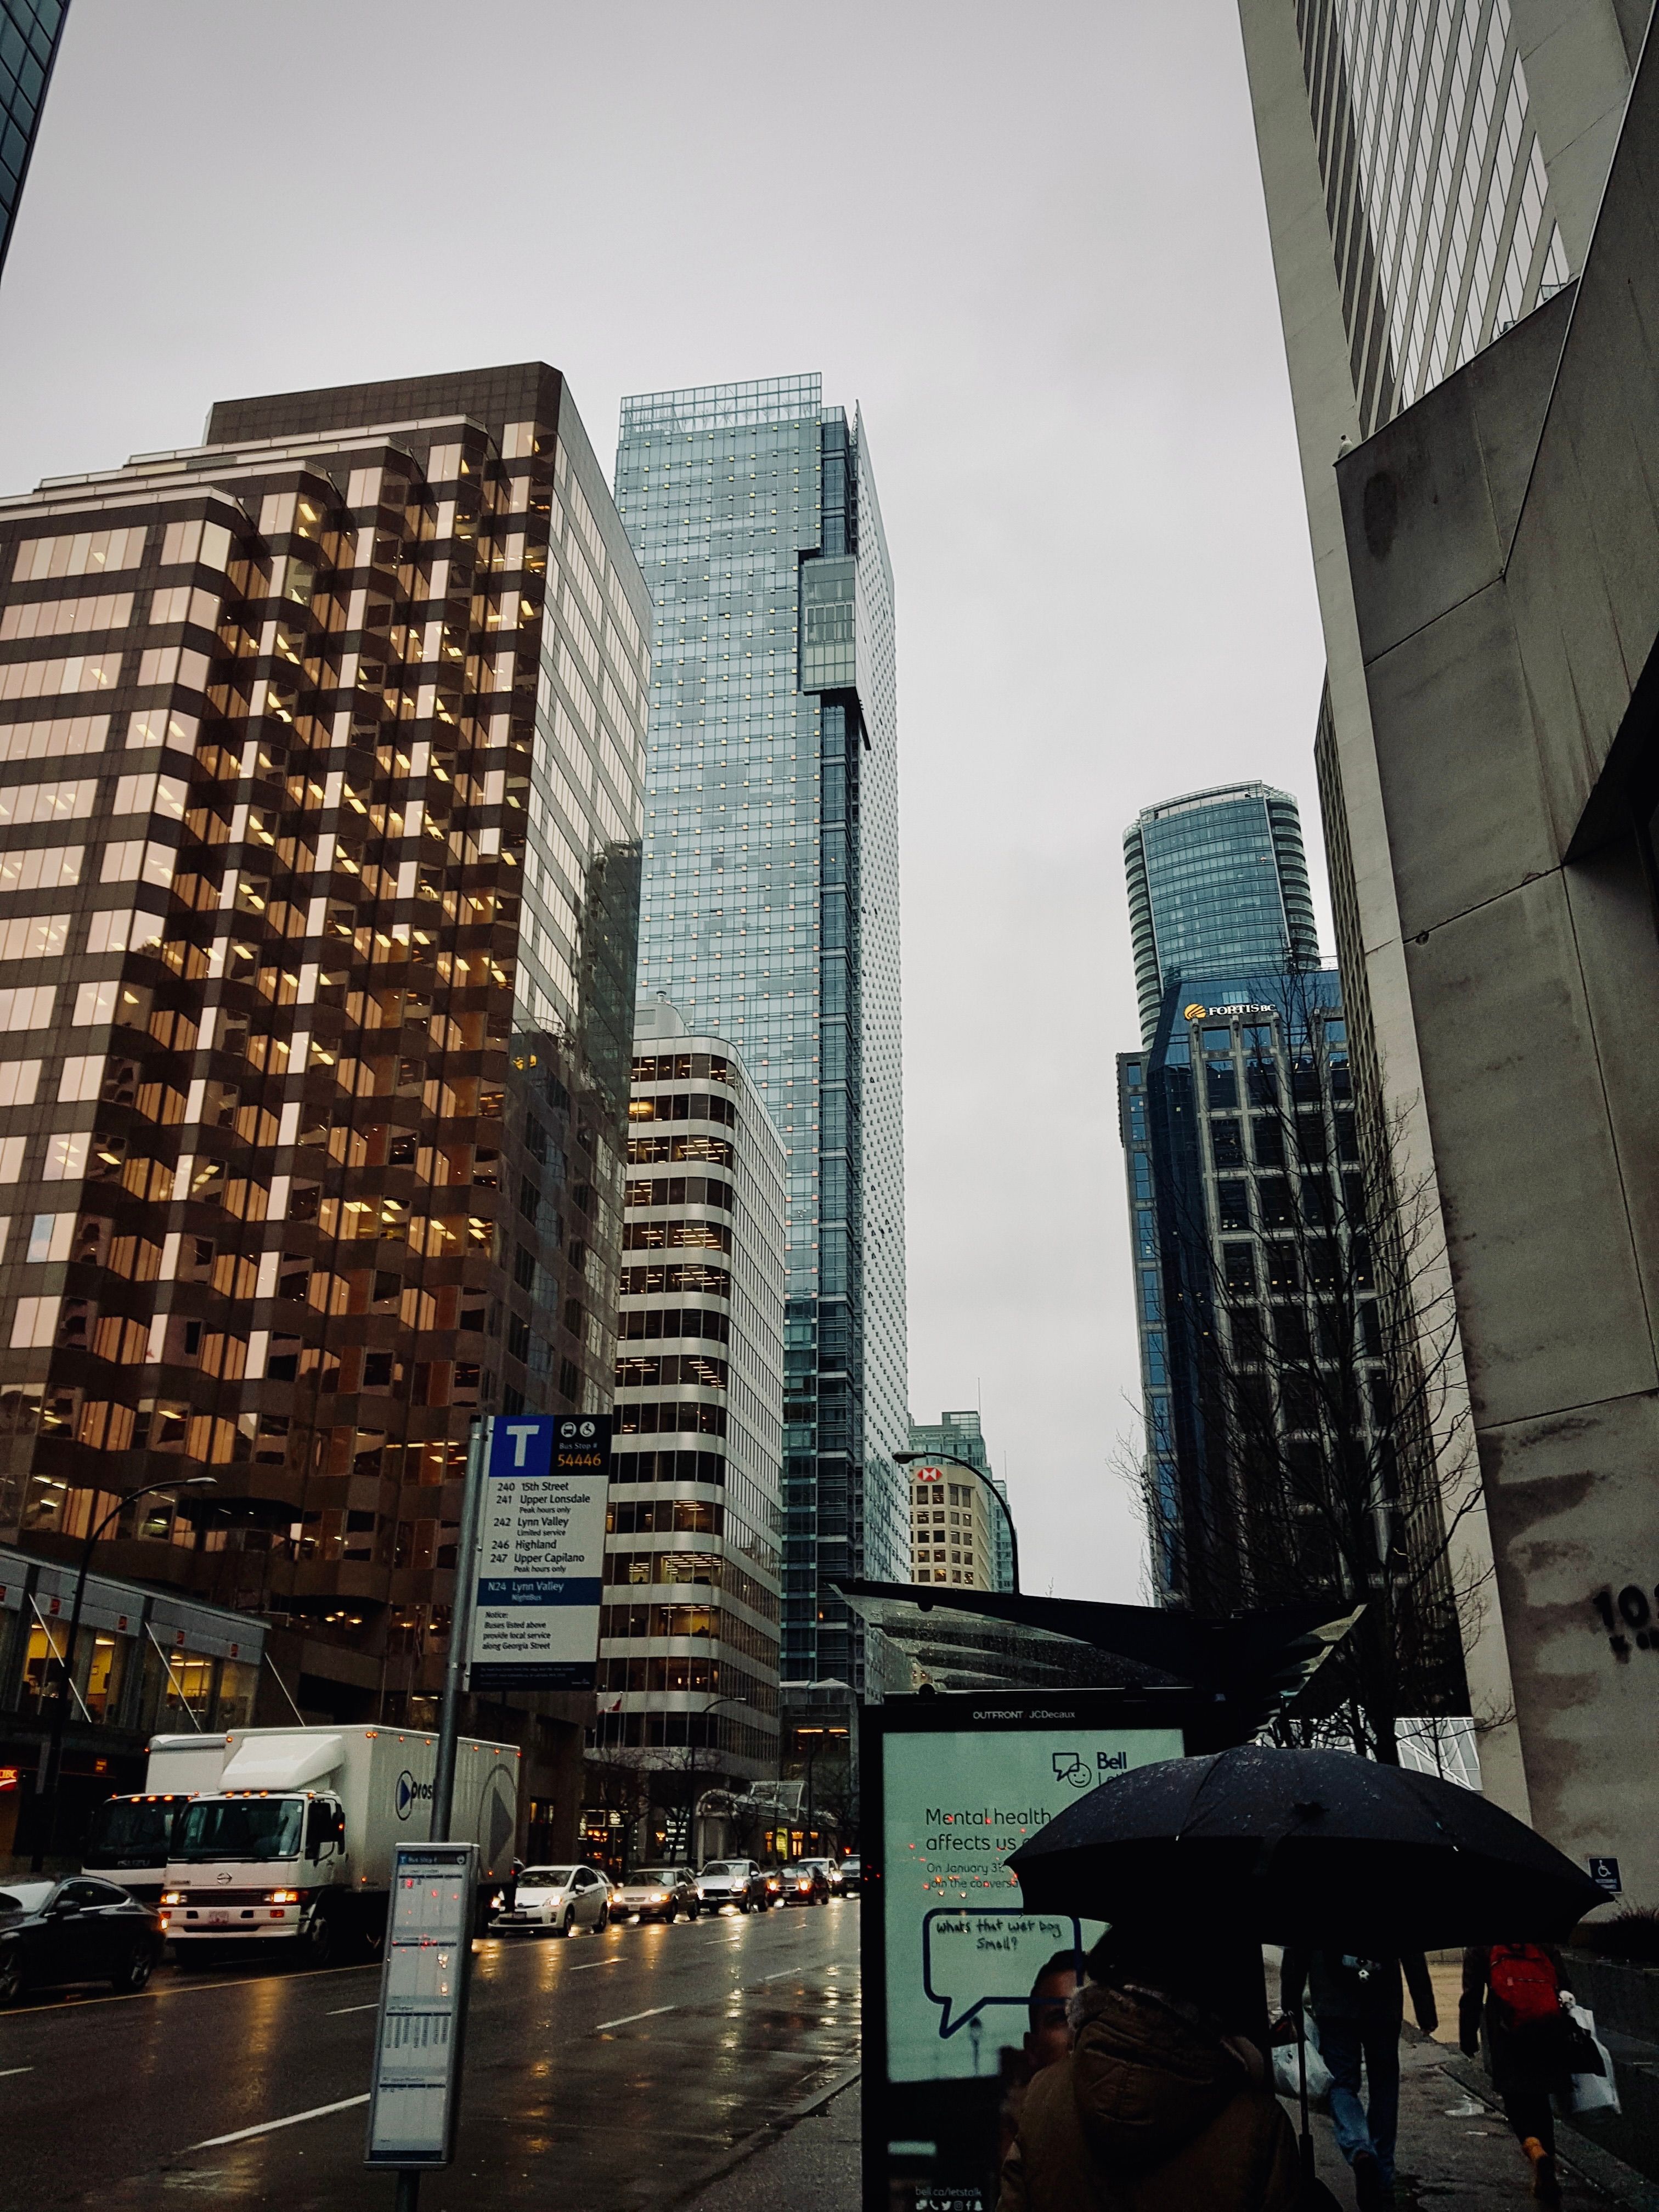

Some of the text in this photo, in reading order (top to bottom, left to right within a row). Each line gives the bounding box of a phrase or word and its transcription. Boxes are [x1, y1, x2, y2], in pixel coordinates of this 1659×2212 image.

[506, 1425, 540, 1467] T
[574, 1442, 591, 1451] Stop
[557, 1453, 601, 1467] 54446
[498, 1481, 569, 1491] 240 15th Street
[496, 1494, 590, 1505] 241 Upper Lonsdale
[494, 1516, 569, 1528] 242 Lynn Valley
[492, 1539, 557, 1551] 246 Highland
[490, 1553, 585, 1564] 247 Upper Capilano
[551, 1565, 566, 1573] only
[488, 1581, 564, 1593] N24 Lynn Valley
[1592, 1584, 1659, 1632] 10
[483, 1632, 508, 1640] provide
[482, 1643, 501, 1651] along
[503, 1642, 528, 1651] Georgia
[973, 1710, 1076, 1719] OUTFRONT JCDecaux
[1097, 1752, 1127, 1769] Bell
[926, 1808, 1051, 1825] Mental health
[926, 1833, 991, 1850] affects
[996, 1838, 1016, 1850] us
[927, 1863, 941, 1872] On
[945, 1864, 988, 1875] January
[951, 1878, 967, 1888] the
